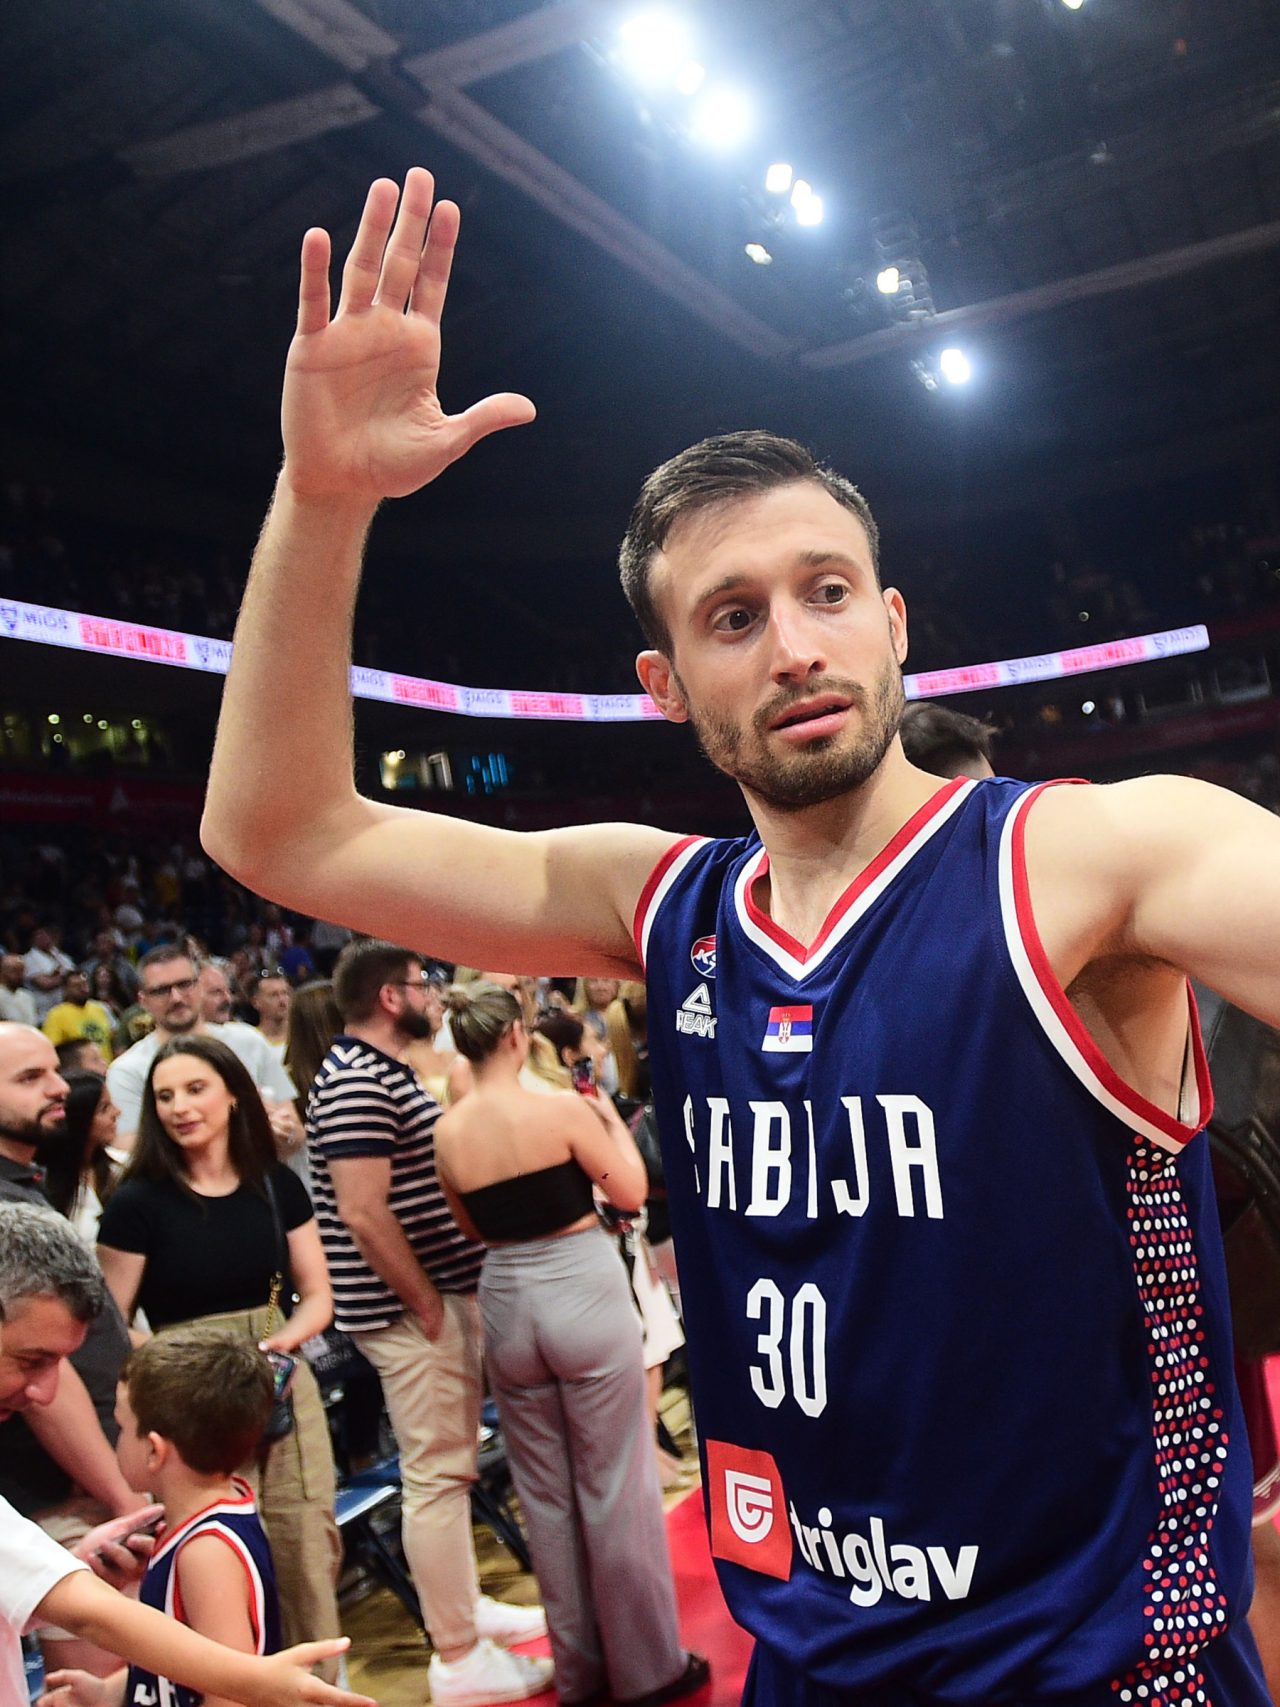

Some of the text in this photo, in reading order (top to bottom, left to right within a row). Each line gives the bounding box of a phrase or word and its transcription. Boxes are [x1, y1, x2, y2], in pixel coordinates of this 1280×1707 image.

[676, 1009, 718, 1039] PEAK
[746, 1278, 828, 1418] 30
[790, 1500, 980, 1607] triglav
